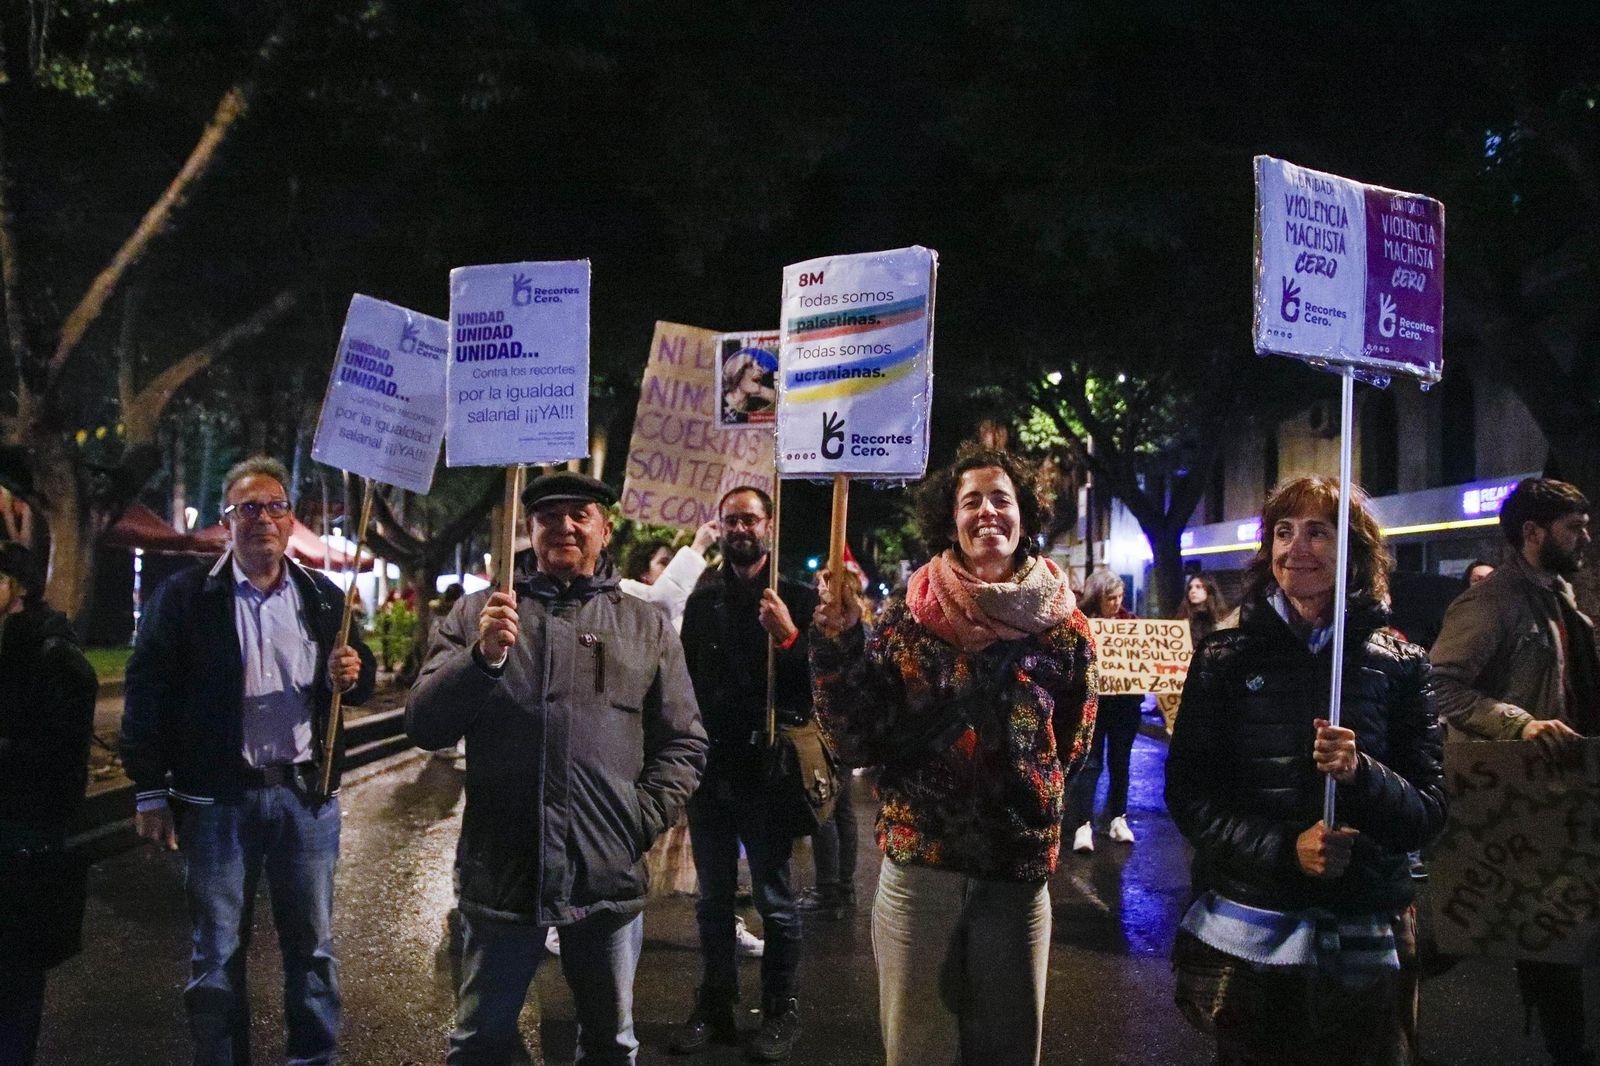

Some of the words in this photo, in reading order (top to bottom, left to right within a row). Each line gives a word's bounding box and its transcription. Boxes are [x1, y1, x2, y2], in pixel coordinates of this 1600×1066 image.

[1285, 194, 1349, 229] VIOLENCIA
[1285, 221, 1346, 255] MACHISTA
[1381, 213, 1436, 245] VIOLENCIA
[1384, 239, 1434, 270] MACHISTA
[1295, 251, 1338, 279] CERO
[798, 271, 824, 288] 8M
[1391, 266, 1427, 293] CERO
[534, 286, 580, 296] Recortes
[534, 294, 563, 304] Cero.
[798, 295, 838, 309] Todas
[842, 290, 894, 304] somos
[457, 310, 505, 327] UNIDAD
[1304, 302, 1347, 320] Recortes
[1304, 313, 1332, 327] Cero.
[796, 312, 881, 335] palestinas.
[1400, 317, 1435, 333] Recortes
[456, 324, 513, 343] UNIDAD
[1400, 328, 1422, 341] Cero.
[349, 339, 391, 361] UNIDAD
[456, 341, 540, 363] UNIDAD...
[657, 333, 687, 367] NI
[796, 346, 836, 360] Todas
[839, 342, 892, 356] somos
[344, 353, 395, 378] UNIDAD
[472, 367, 508, 379] Contra
[511, 366, 526, 376] los
[529, 365, 575, 376] recortes
[795, 365, 886, 384] ucranianas.
[340, 367, 410, 403] UNIDAD...
[458, 389, 484, 405] por
[488, 385, 502, 399] la
[506, 382, 575, 403] igualdad
[646, 374, 680, 411] NI
[467, 406, 520, 424] salarial
[525, 405, 575, 424] ¡¡¡YA!!!
[335, 405, 357, 424] por
[360, 412, 371, 426] la
[374, 418, 433, 446] igualdad
[338, 426, 383, 449] salarial
[851, 433, 912, 446] Recortes
[851, 444, 890, 457] Cero.
[629, 449, 680, 486] SON
[622, 487, 656, 520] DE
[1094, 620, 1139, 635] JUEZ
[1145, 623, 1184, 639] DIJO
[1102, 648, 1122, 658] UN
[1155, 638, 1184, 650] NO
[1129, 662, 1150, 673] LA
